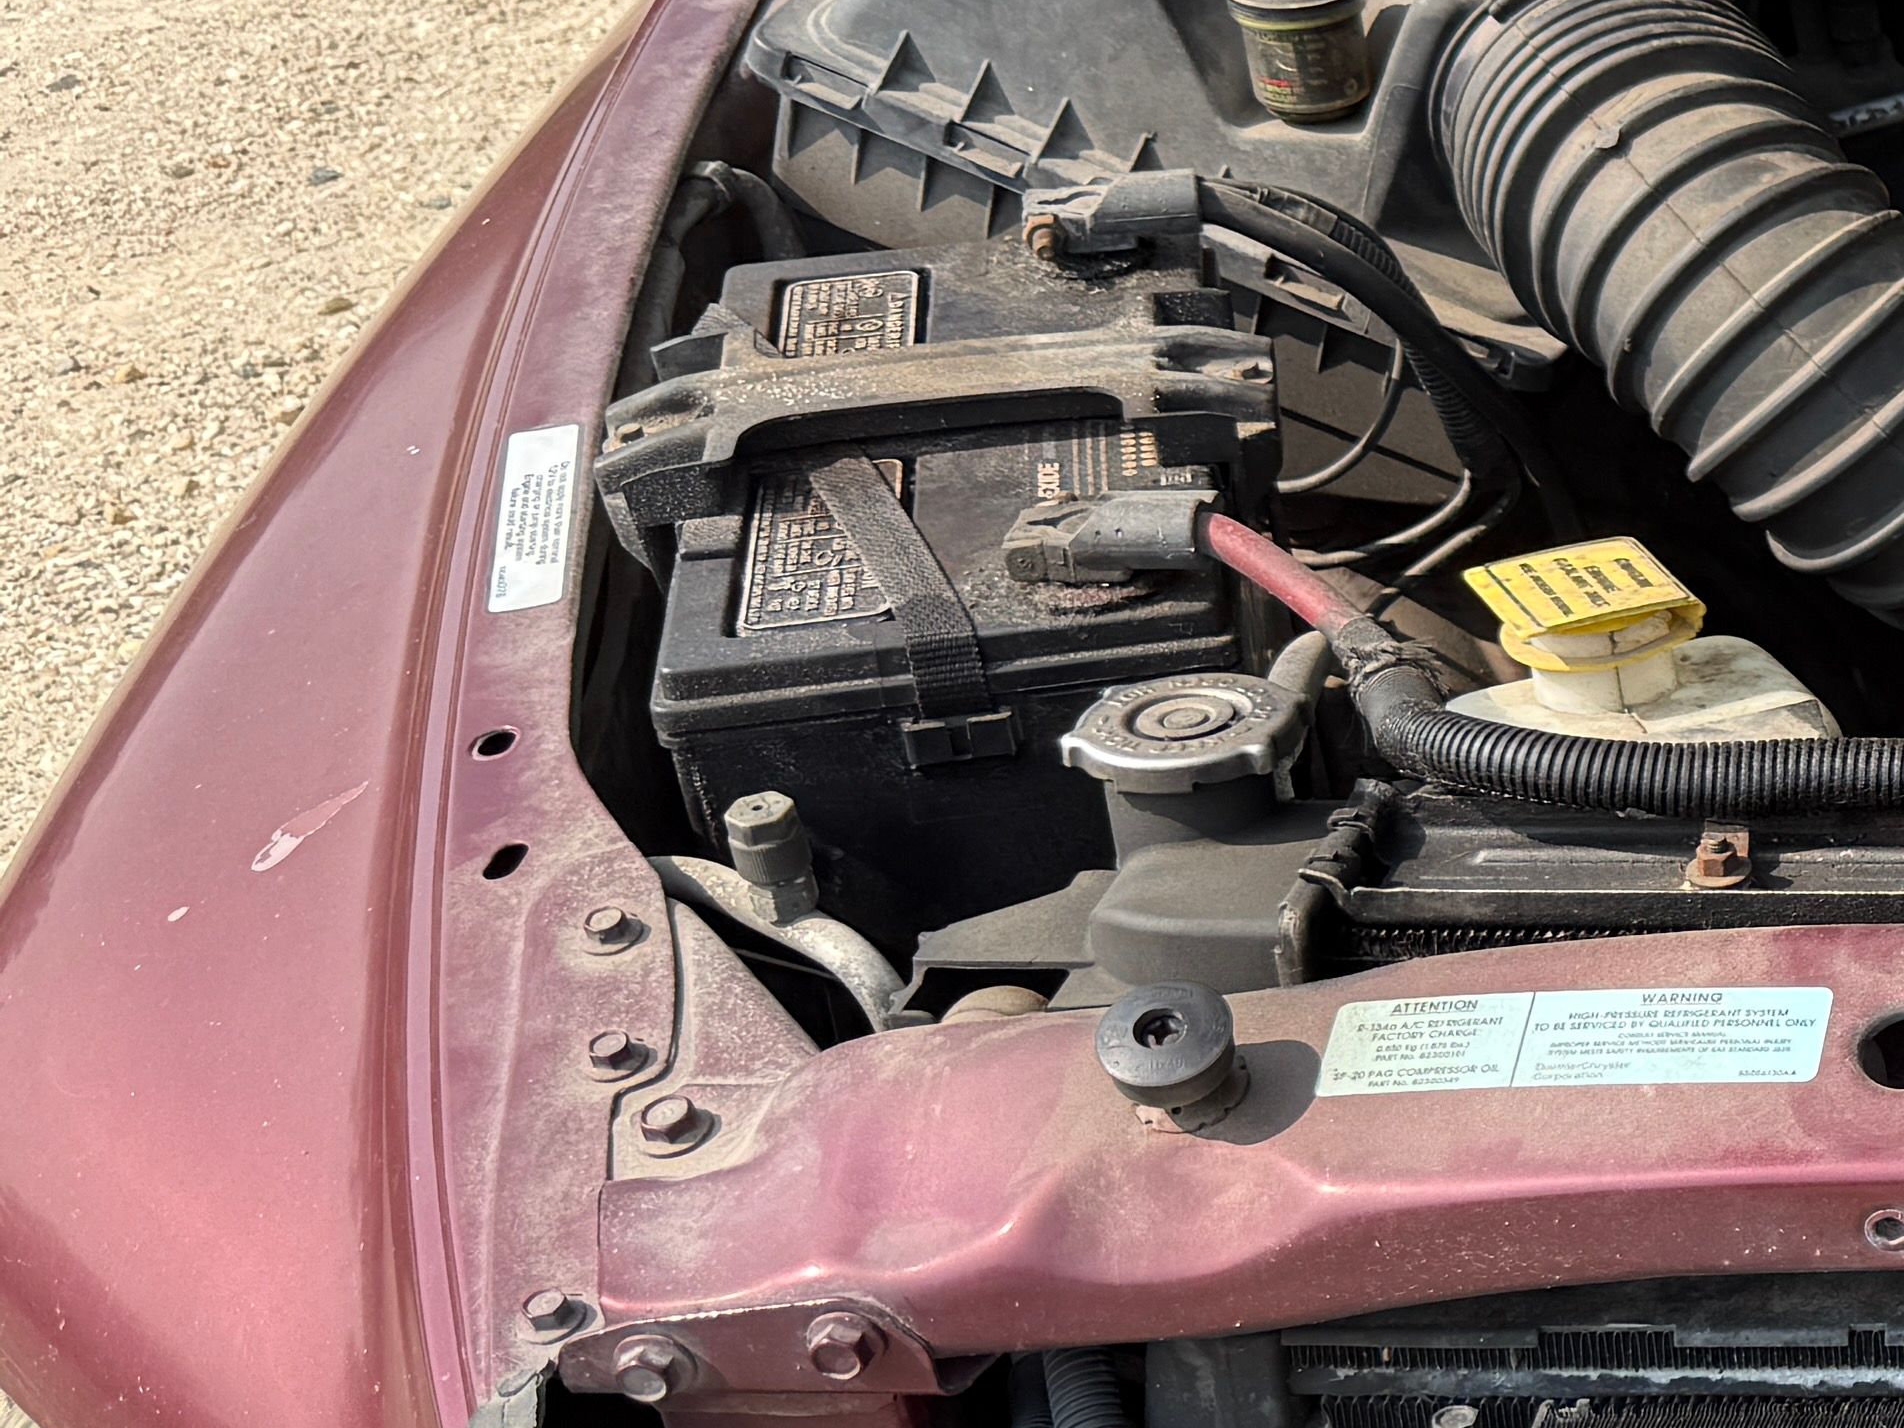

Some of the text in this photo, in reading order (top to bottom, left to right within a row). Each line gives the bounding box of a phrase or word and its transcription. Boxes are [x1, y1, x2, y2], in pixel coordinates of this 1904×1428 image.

[1641, 992, 1723, 1004] WARNING
[1391, 999, 1479, 1014] ATTENTION
[1663, 1008, 1742, 1018] REFRIGERANT
[1745, 1008, 1789, 1017] SYSTEM
[1400, 1020, 1424, 1030] A/C
[1427, 1016, 1504, 1028] REFRIGERANT
[1534, 1018, 1817, 1032] TO BE SERVICED BY QUALIFIED PERSONNEL ONLY
[1371, 1030, 1425, 1041] FACTORY
[1367, 1069, 1393, 1079] PAG
[1397, 1065, 1478, 1077] COMPRESSOR
[1481, 1063, 1499, 1073] OIL
[1531, 1072, 1604, 1082] Corporation
